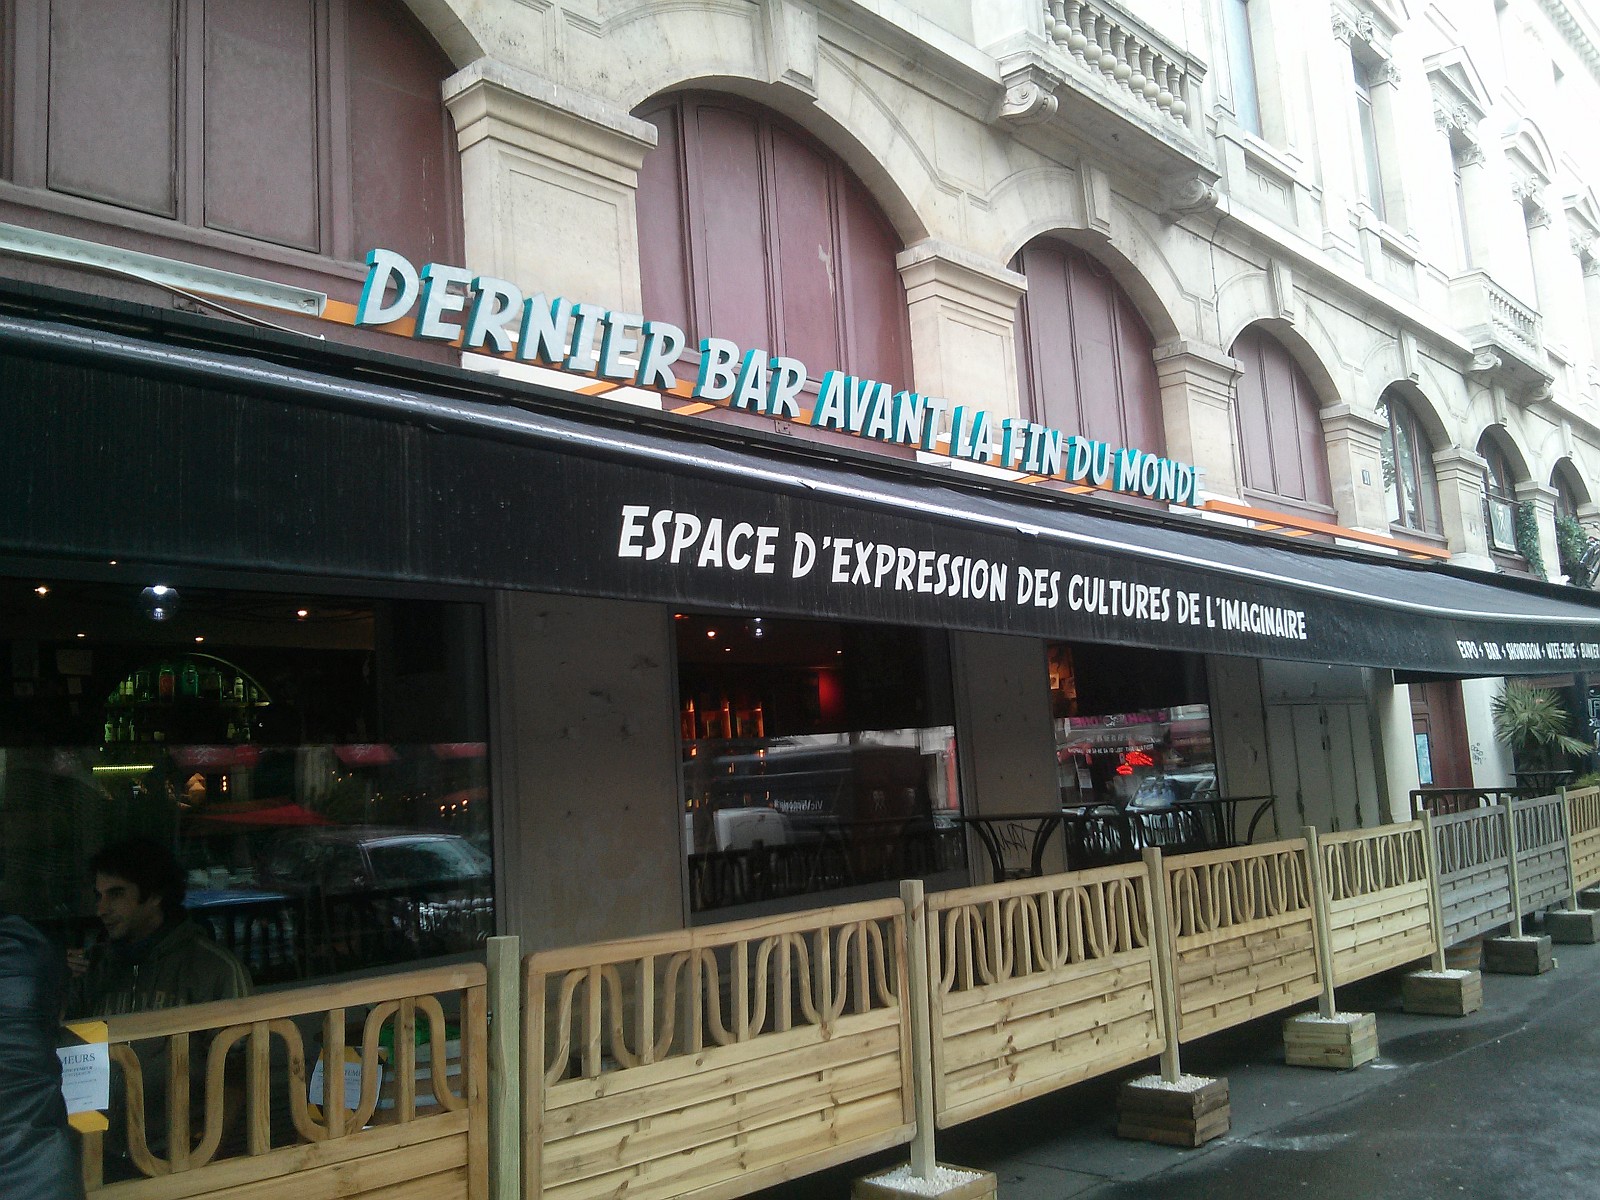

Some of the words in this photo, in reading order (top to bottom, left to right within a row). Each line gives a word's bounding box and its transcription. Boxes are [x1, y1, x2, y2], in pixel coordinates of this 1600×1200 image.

[355, 247, 686, 389] DERNIER
[693, 337, 807, 418] BAR
[811, 369, 949, 451] AVANT
[950, 405, 994, 462] LA
[1002, 417, 1063, 475] FIN
[1066, 435, 1111, 486] DU
[1113, 447, 1207, 508] MONDE
[618, 504, 779, 574] ESPACE
[792, 531, 1008, 602] D'EXPRESSION
[1017, 566, 1061, 609] DES
[1068, 574, 1171, 622] CULTURES
[1177, 590, 1200, 626] DE
[1206, 595, 1308, 641] L'IMAGINAIRE
[1456, 640, 1479, 659] EXPO
[1483, 641, 1502, 660] BAR
[1506, 642, 1541, 660] SHOWROOM
